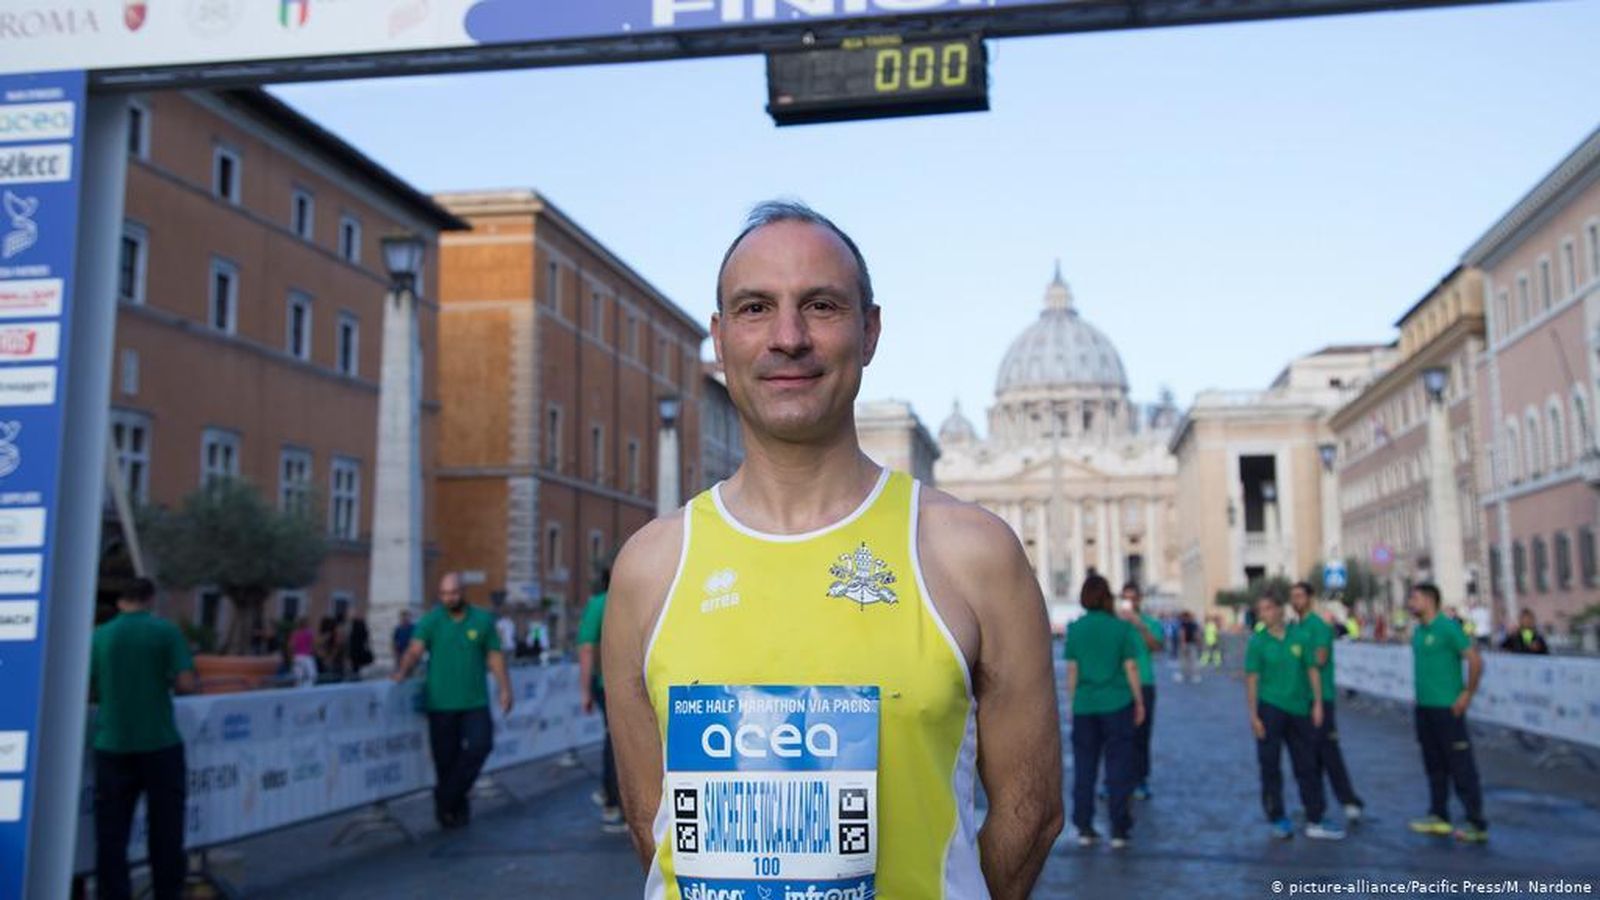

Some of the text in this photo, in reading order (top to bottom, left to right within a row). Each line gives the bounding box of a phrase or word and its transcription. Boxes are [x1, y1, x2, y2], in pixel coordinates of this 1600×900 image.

[0, 8, 100, 38] ROMA
[675, 699, 871, 714] ROME HALF MARATHON VIA PACIS
[702, 723, 838, 758] acea
[704, 781, 832, 853] SANCHEZ DE TOCA ALAMEDA
[753, 857, 781, 876] 100
